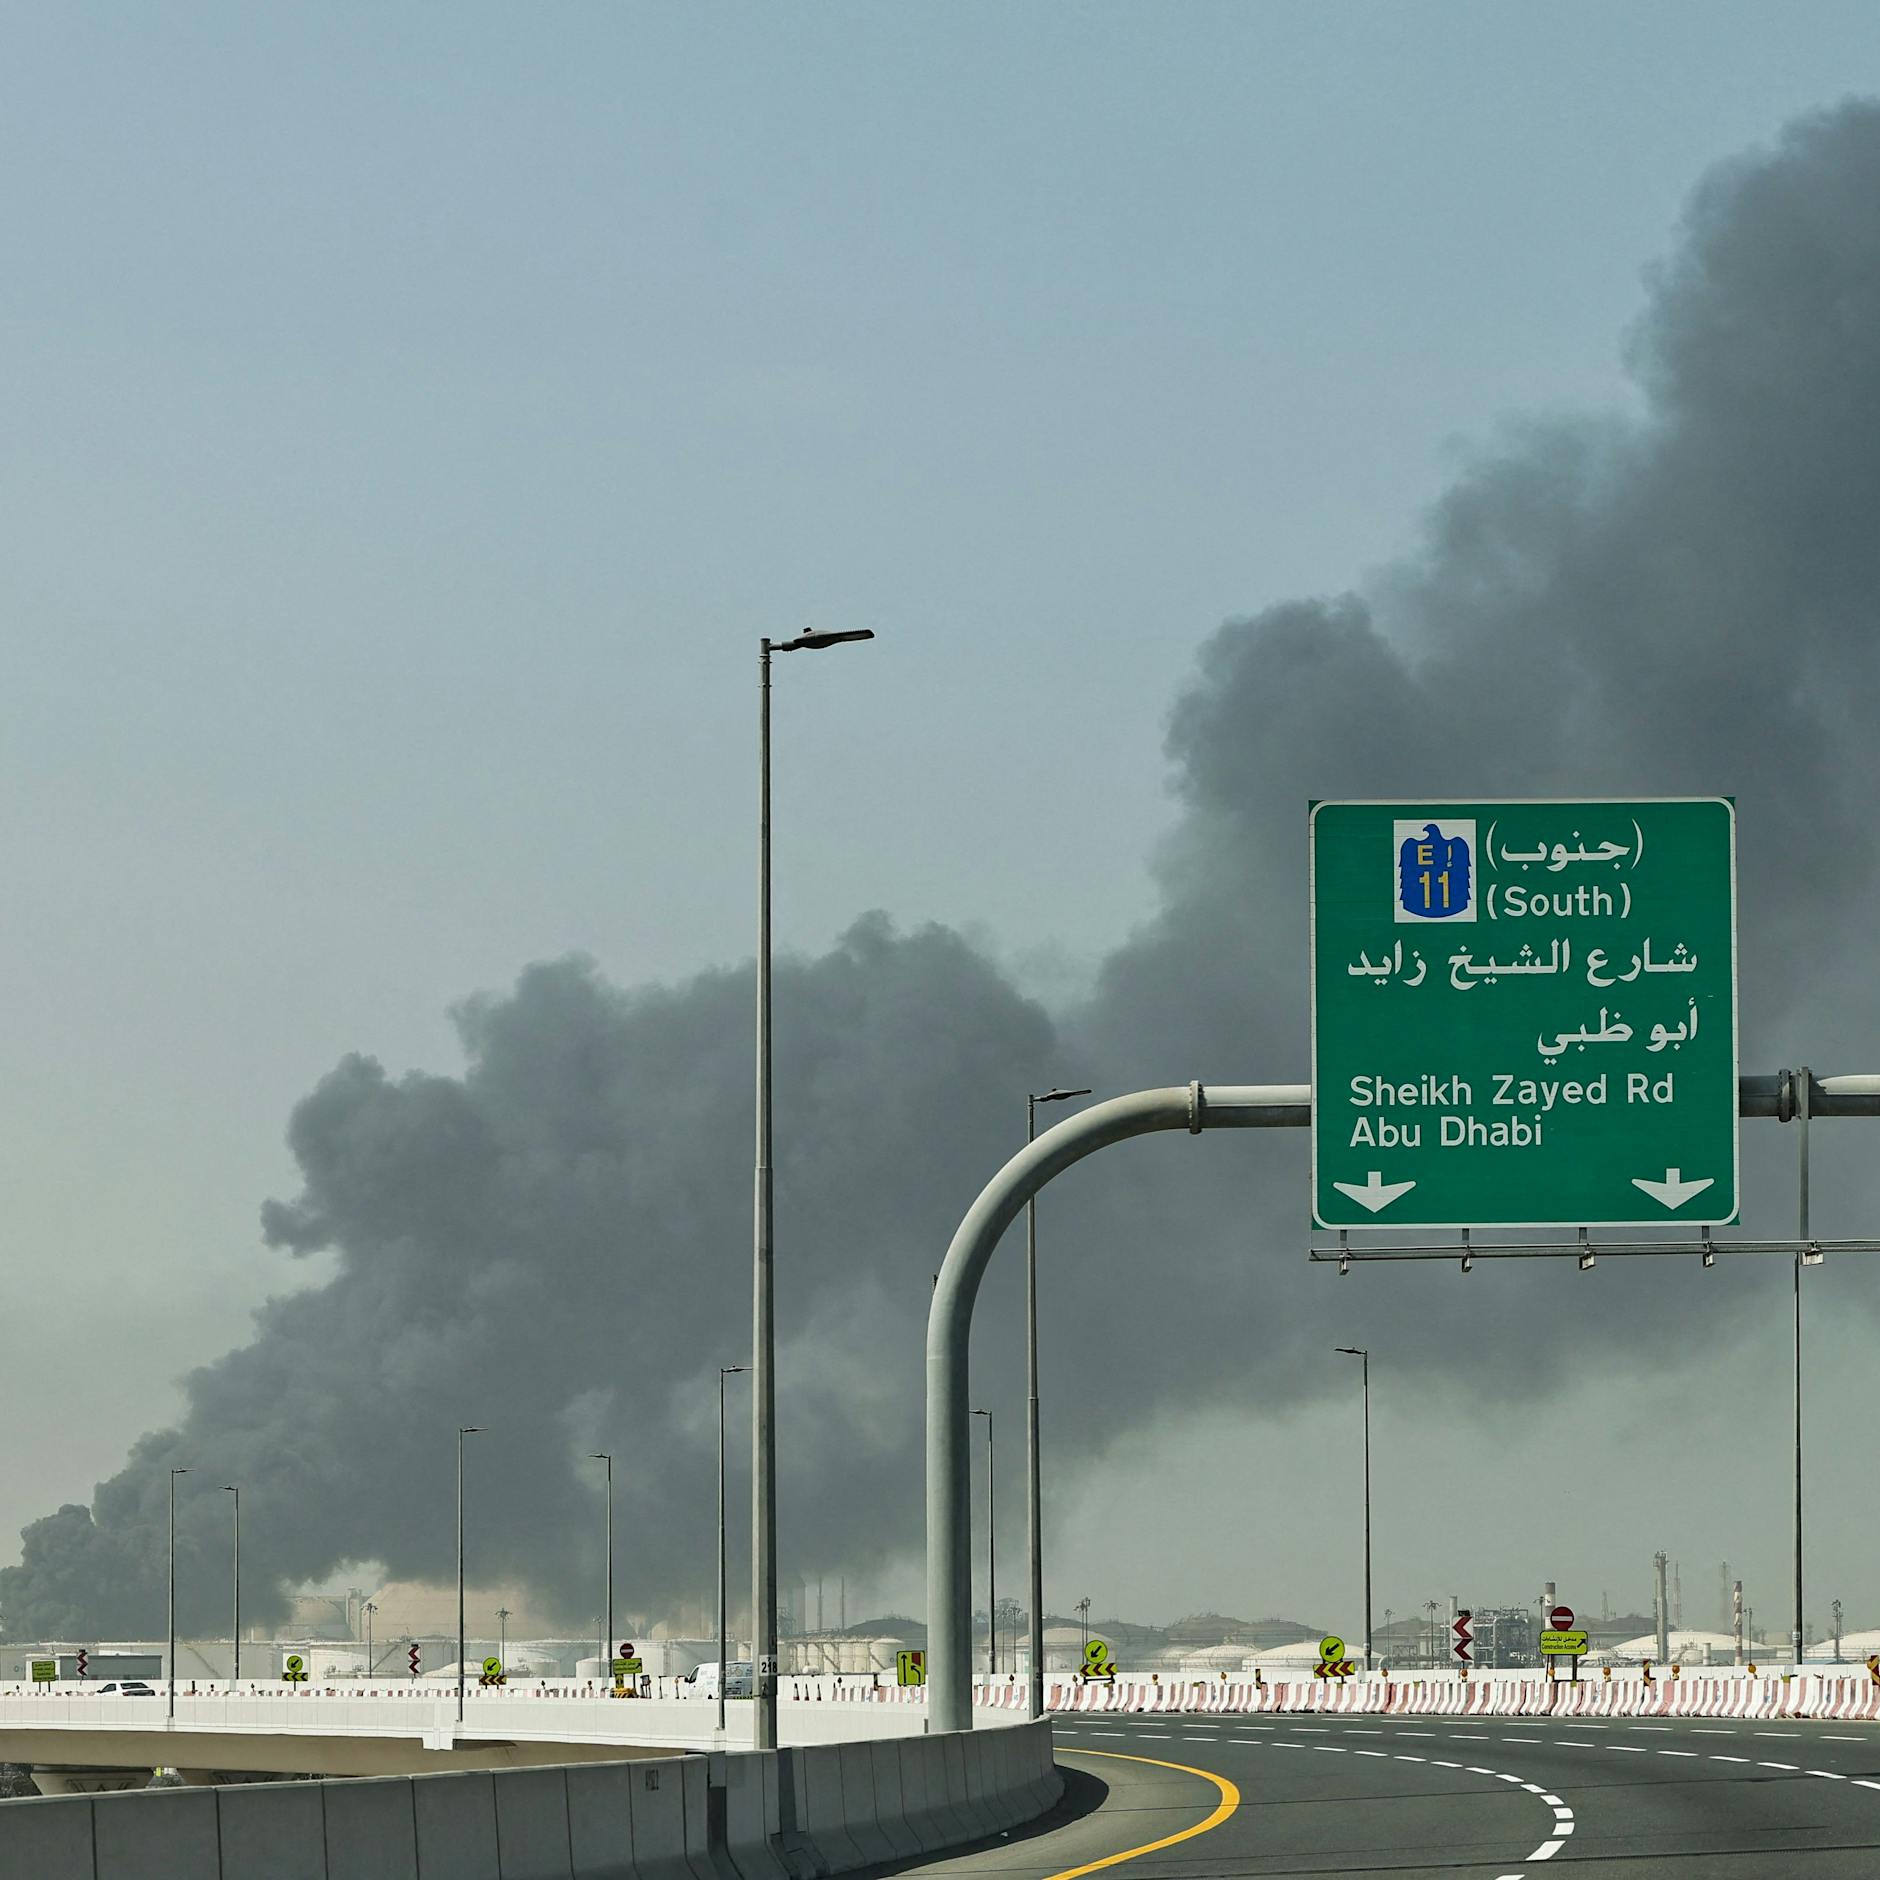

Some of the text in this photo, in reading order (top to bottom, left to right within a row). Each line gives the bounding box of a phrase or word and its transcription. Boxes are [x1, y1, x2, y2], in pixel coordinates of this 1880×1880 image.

[1417, 845, 1434, 865] E
[1486, 820, 1643, 872] (جنوب)
[1419, 871, 1450, 908] 11
[1486, 883, 1631, 920] (South)
[1347, 937, 1698, 991] شارع الشيخ زايد
[1537, 997, 1698, 1065] أبو ظبي
[1349, 1072, 1674, 1111] Sheikh Zayed Rd
[1349, 1114, 1542, 1148] Abu Dhabi
[761, 1661, 778, 1673] 218
